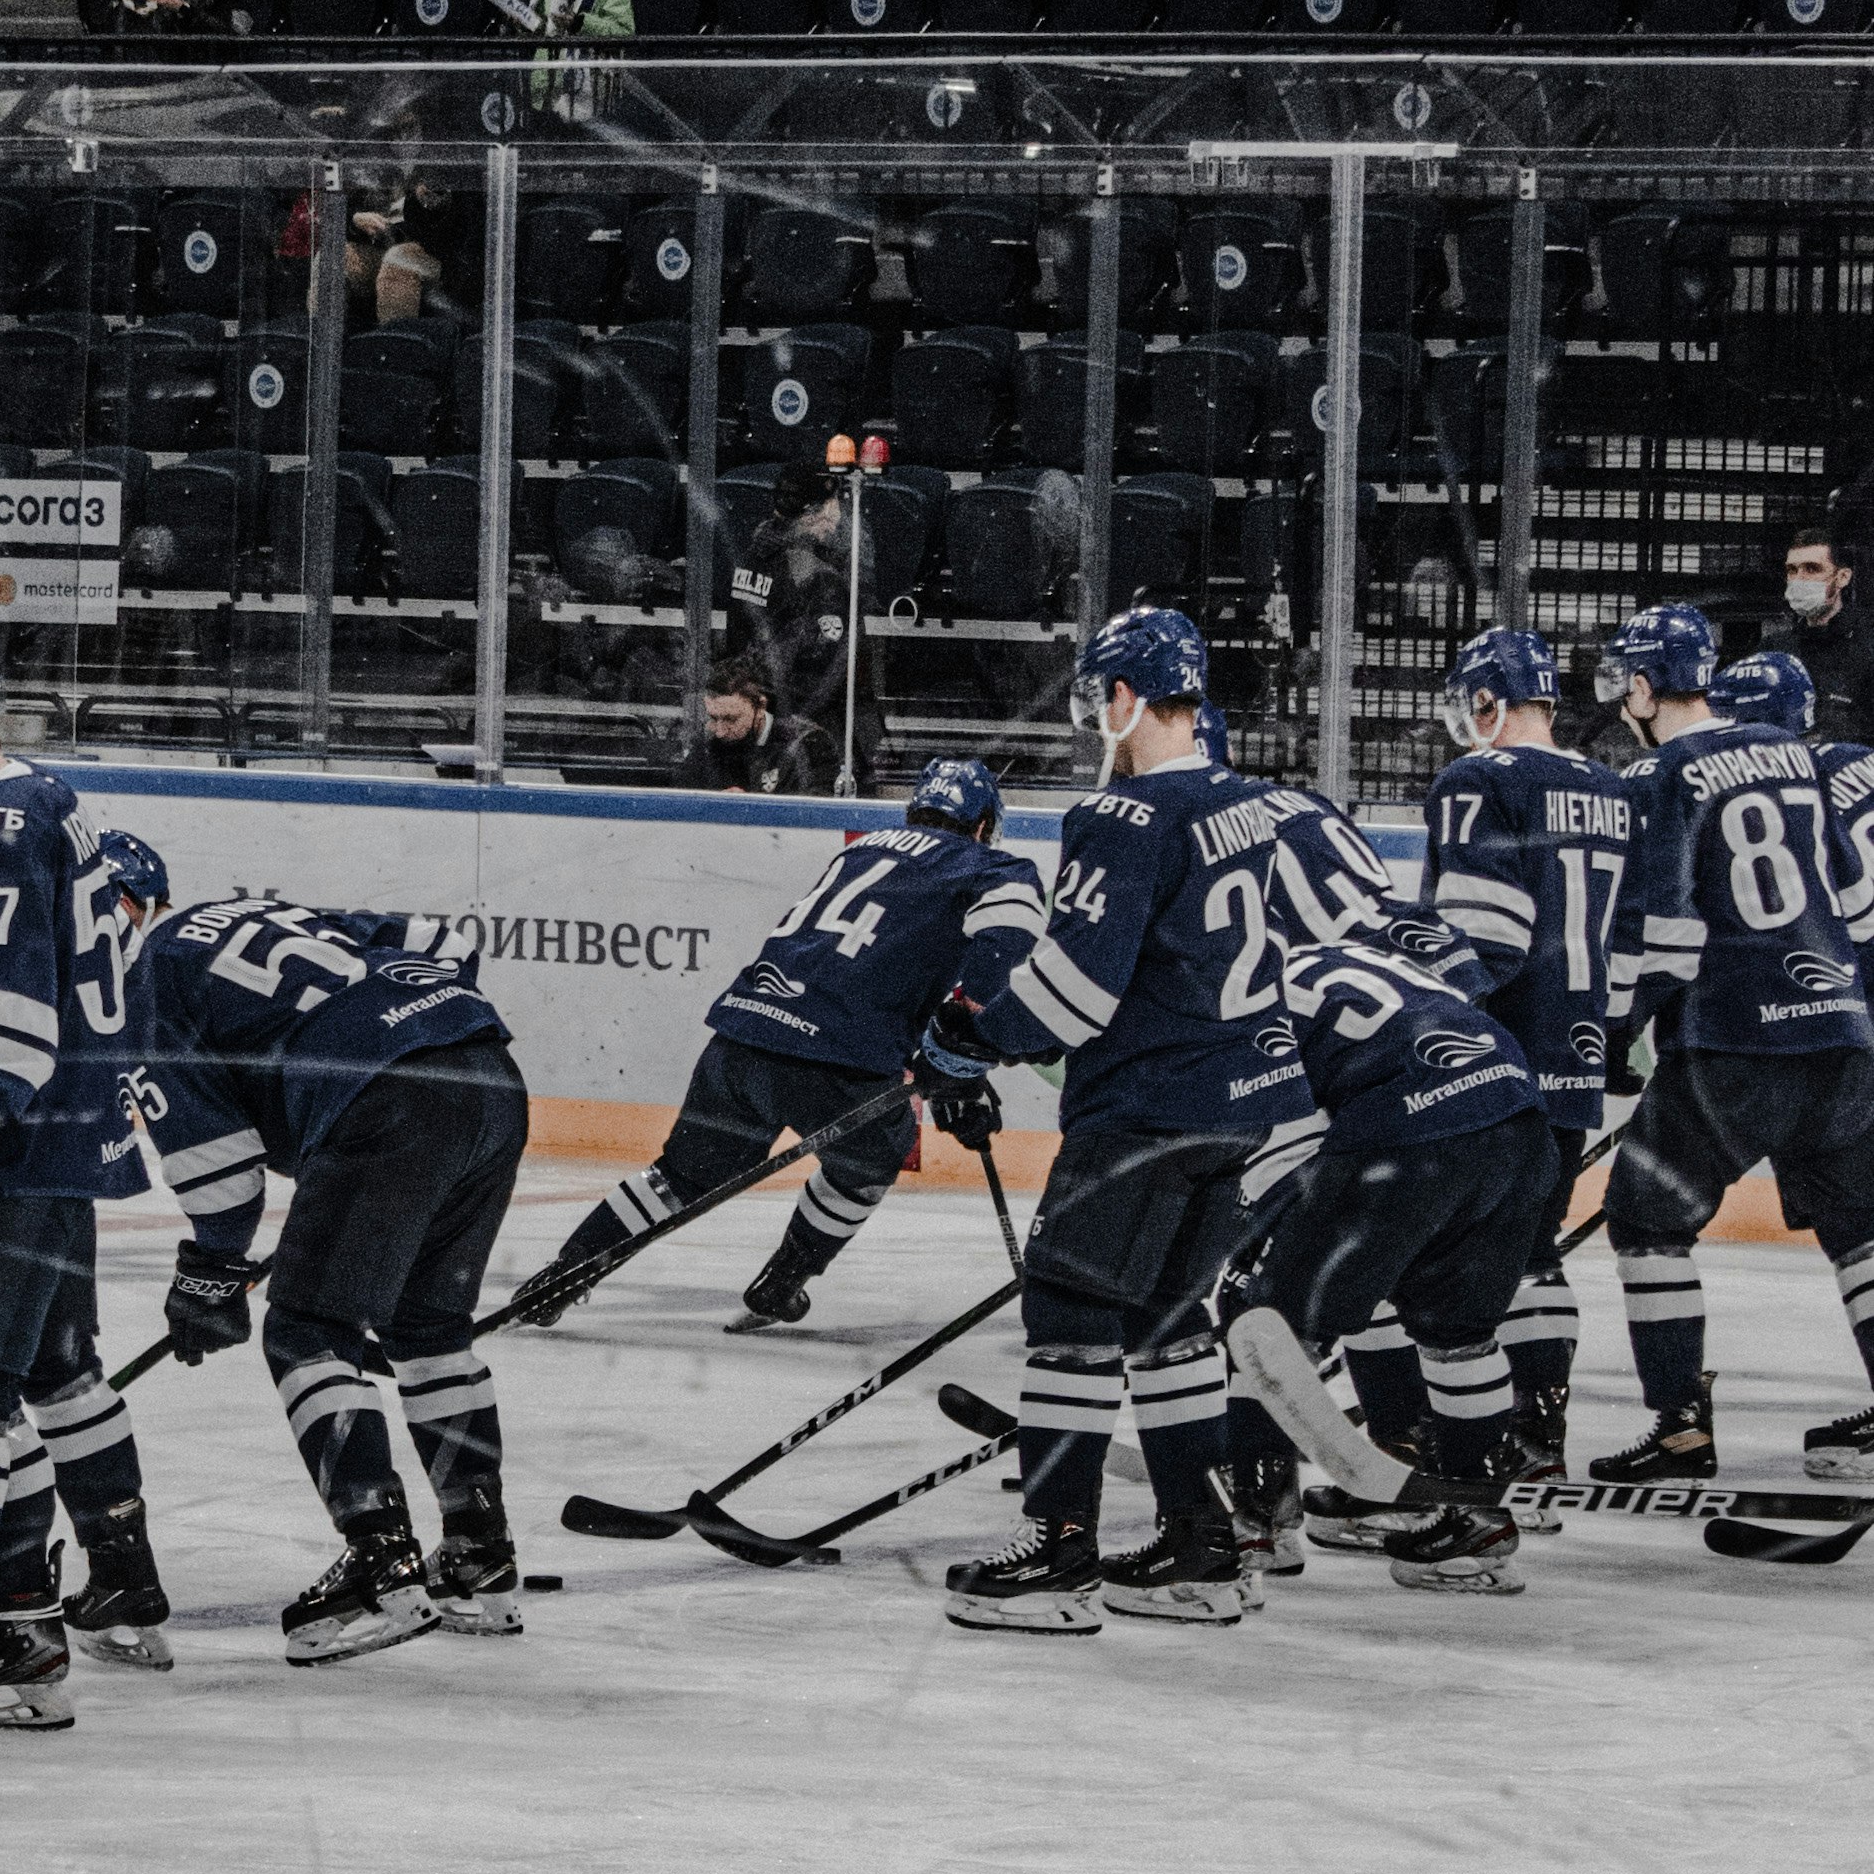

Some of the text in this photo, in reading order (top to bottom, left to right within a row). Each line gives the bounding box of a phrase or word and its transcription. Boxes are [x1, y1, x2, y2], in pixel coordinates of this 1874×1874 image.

[23, 582, 114, 599] mastercard
[1537, 668, 1555, 694] 17
[1095, 794, 1155, 826] ВТБ
[1440, 793, 1483, 845] 17
[1055, 858, 1108, 924] 24
[1721, 787, 1843, 932] 87
[1557, 847, 1627, 995] 17
[780, 1373, 884, 1455] CCM
[896, 1434, 1001, 1508] CCM
